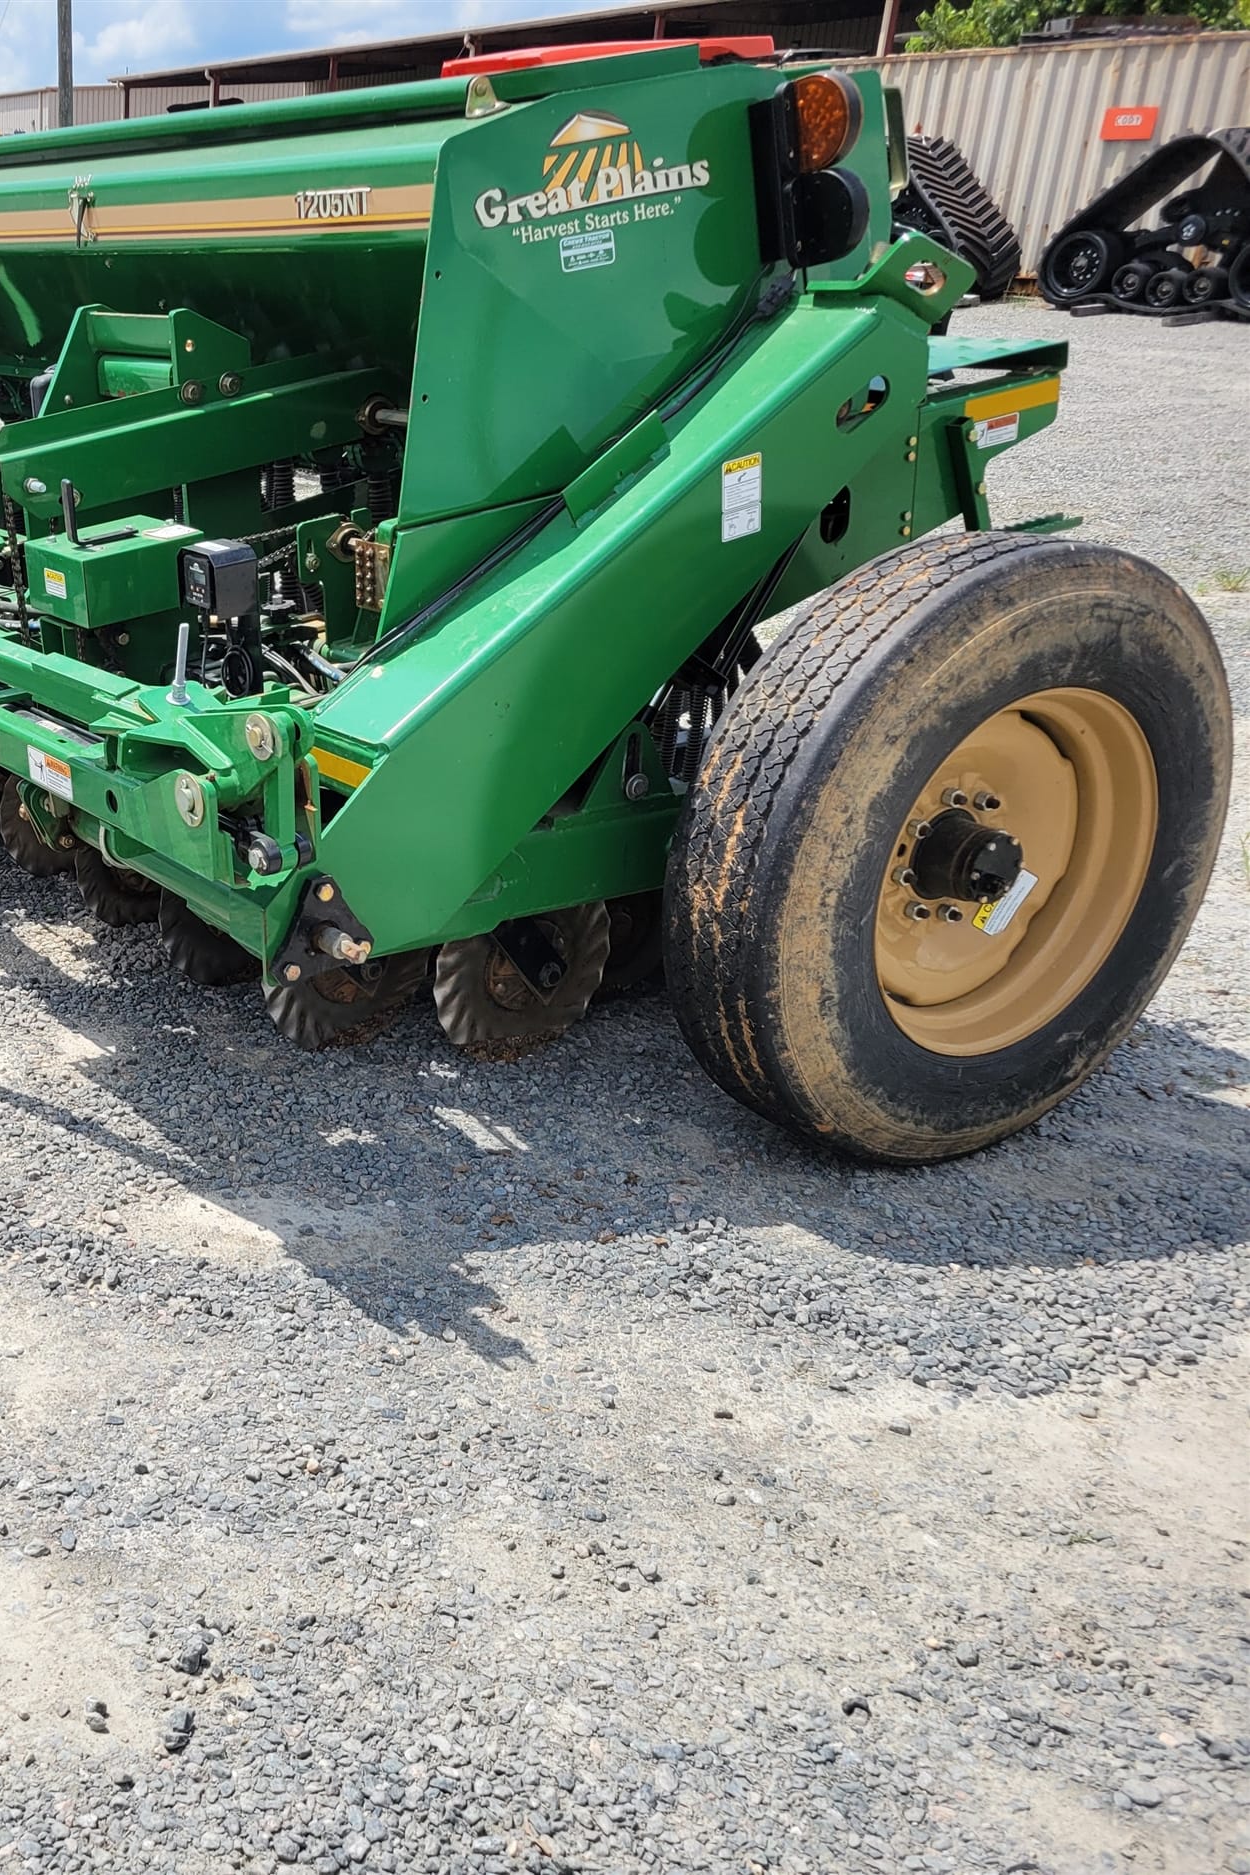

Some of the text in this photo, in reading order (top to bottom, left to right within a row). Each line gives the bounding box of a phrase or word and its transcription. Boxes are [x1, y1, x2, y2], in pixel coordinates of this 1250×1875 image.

[295, 186, 371, 219] 1205NT
[475, 157, 710, 228] Great Plains
[585, 210, 630, 231] Starts
[731, 455, 760, 470] CAUTION
